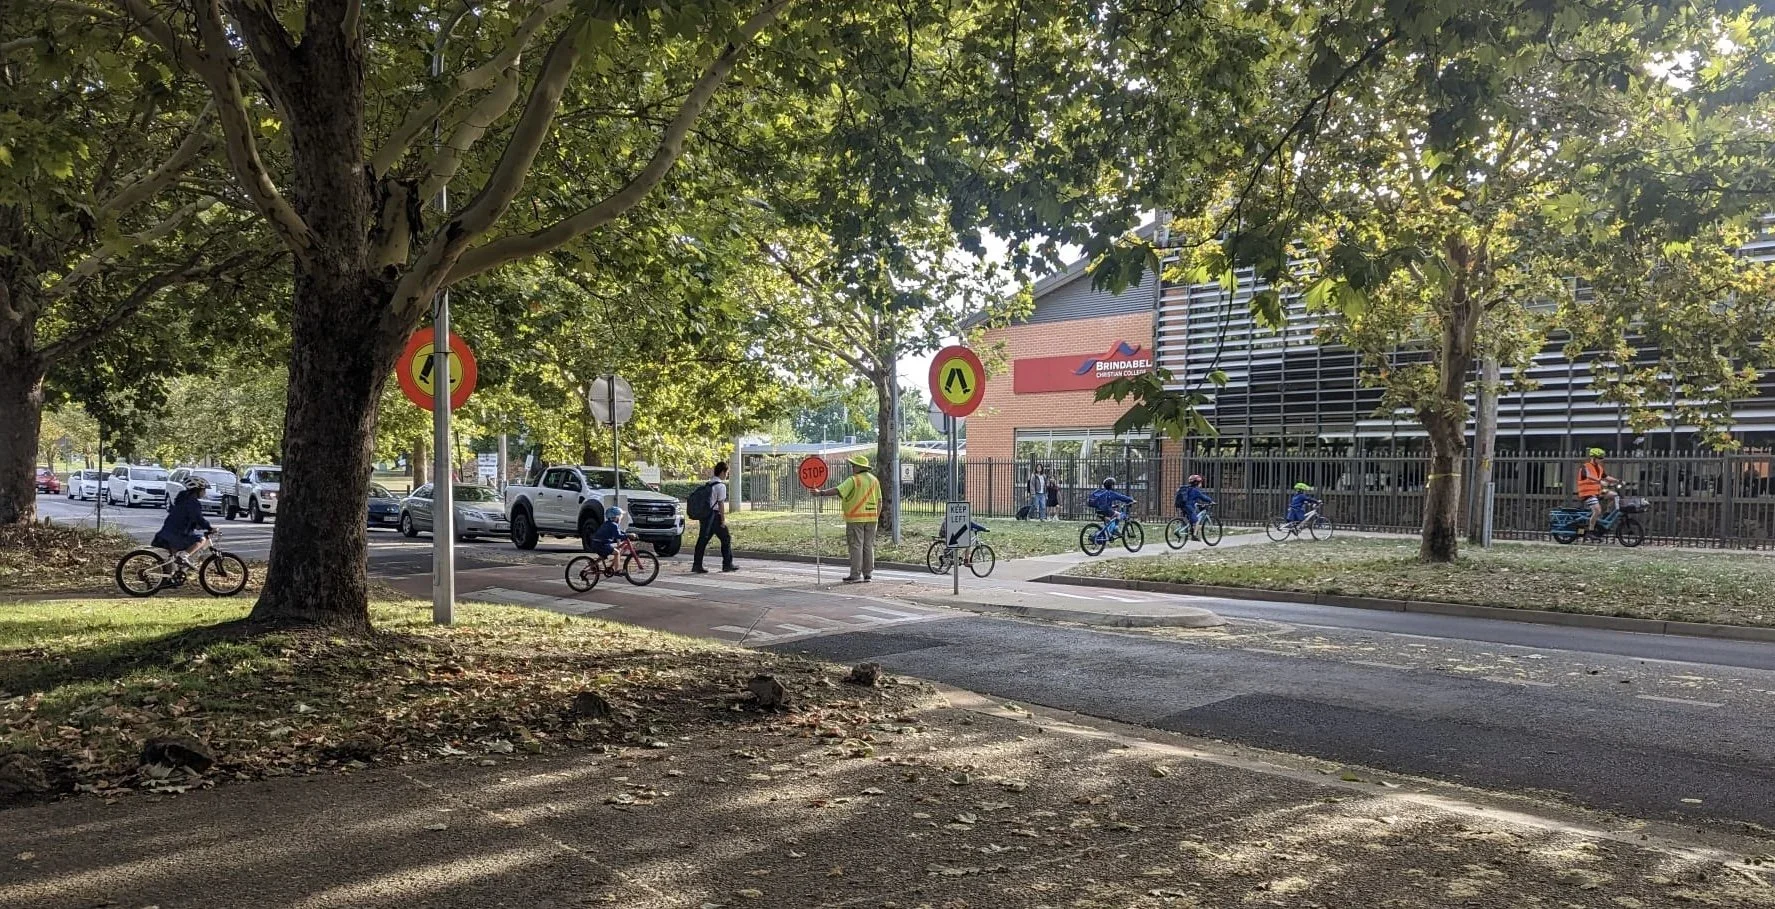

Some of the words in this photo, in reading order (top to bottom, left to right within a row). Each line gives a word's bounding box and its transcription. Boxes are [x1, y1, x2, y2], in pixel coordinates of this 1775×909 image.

[802, 466, 825, 480] STOP
[951, 505, 967, 513] KEEP
[952, 515, 966, 523] LEFT
